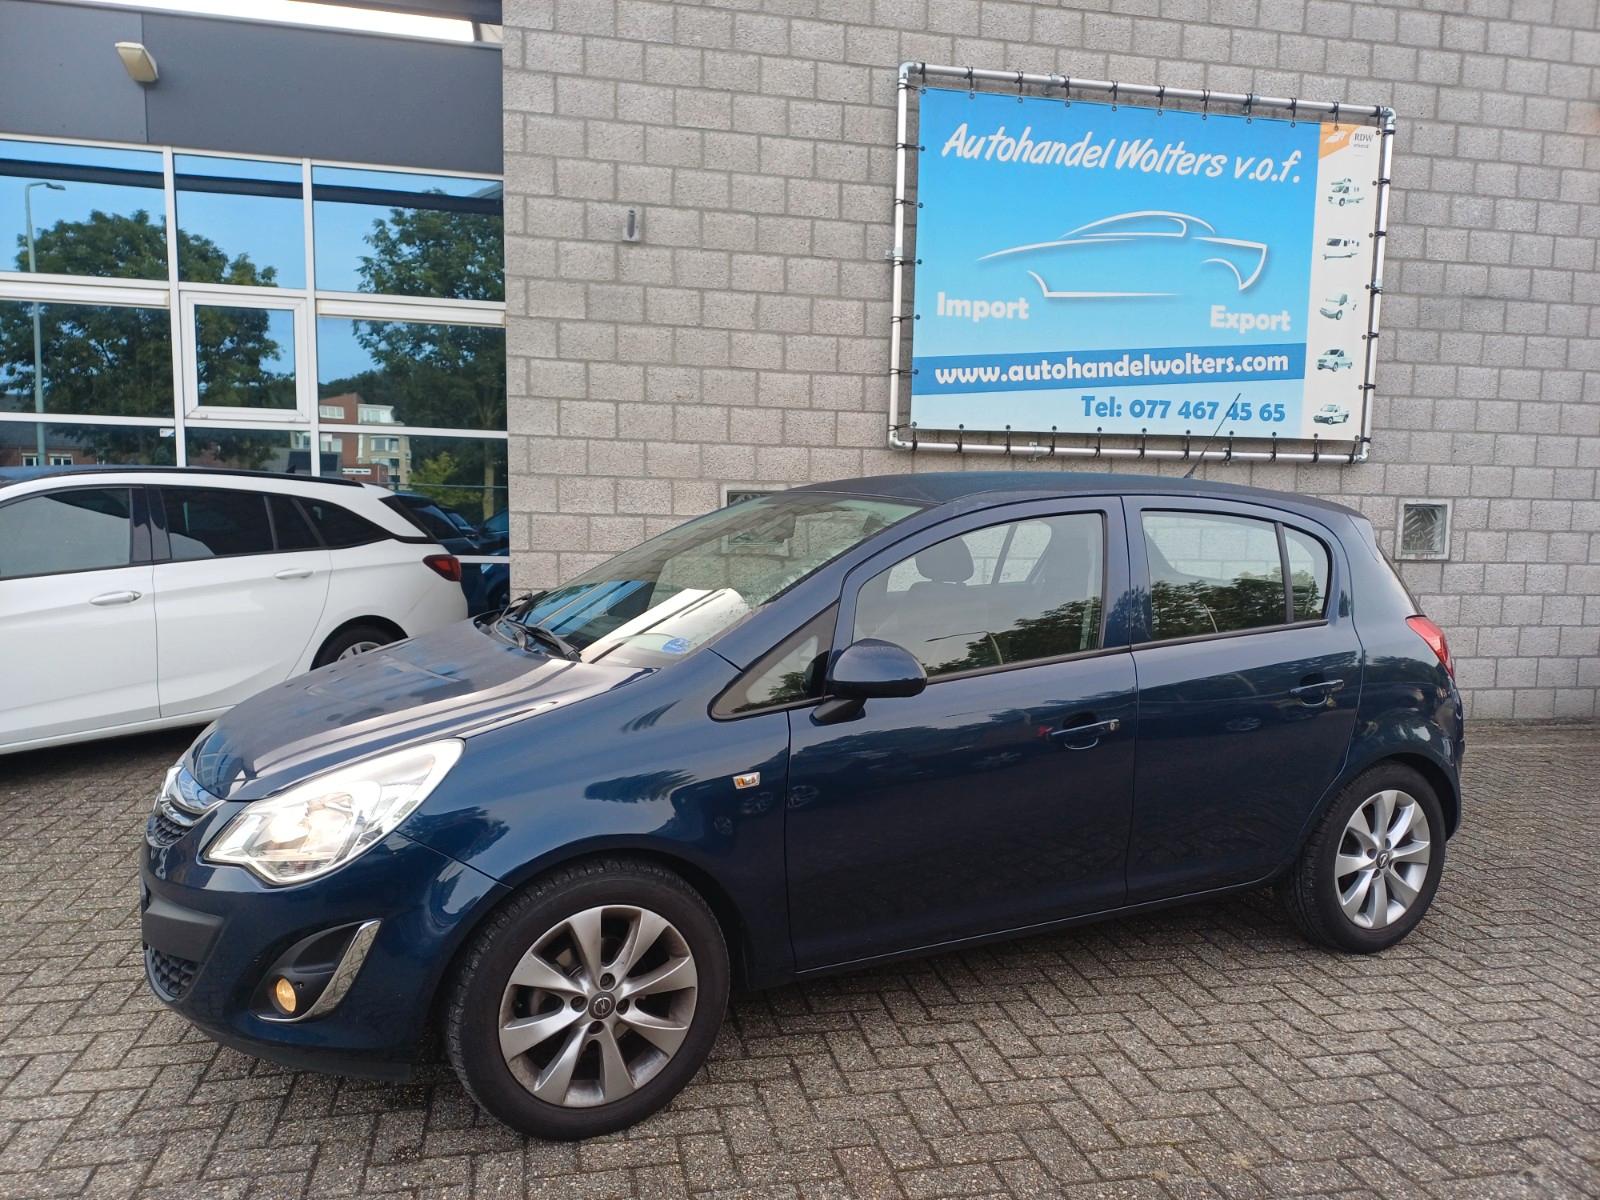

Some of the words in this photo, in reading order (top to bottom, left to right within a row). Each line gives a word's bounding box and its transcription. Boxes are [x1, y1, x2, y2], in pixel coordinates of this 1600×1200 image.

[1354, 132, 1374, 142] RDW
[941, 123, 1116, 169] Autohandel
[1115, 138, 1227, 178] Wolters
[1234, 151, 1300, 184] v.o.f.
[937, 292, 1029, 322] Import
[1210, 305, 1291, 333] Export
[935, 353, 1289, 384] www.autohandelwolters.com
[1081, 395, 1122, 418] Tel:
[1129, 400, 1171, 419] 077
[1178, 401, 1220, 420] 467
[1227, 402, 1251, 421] 45
[1259, 403, 1285, 422] 65
